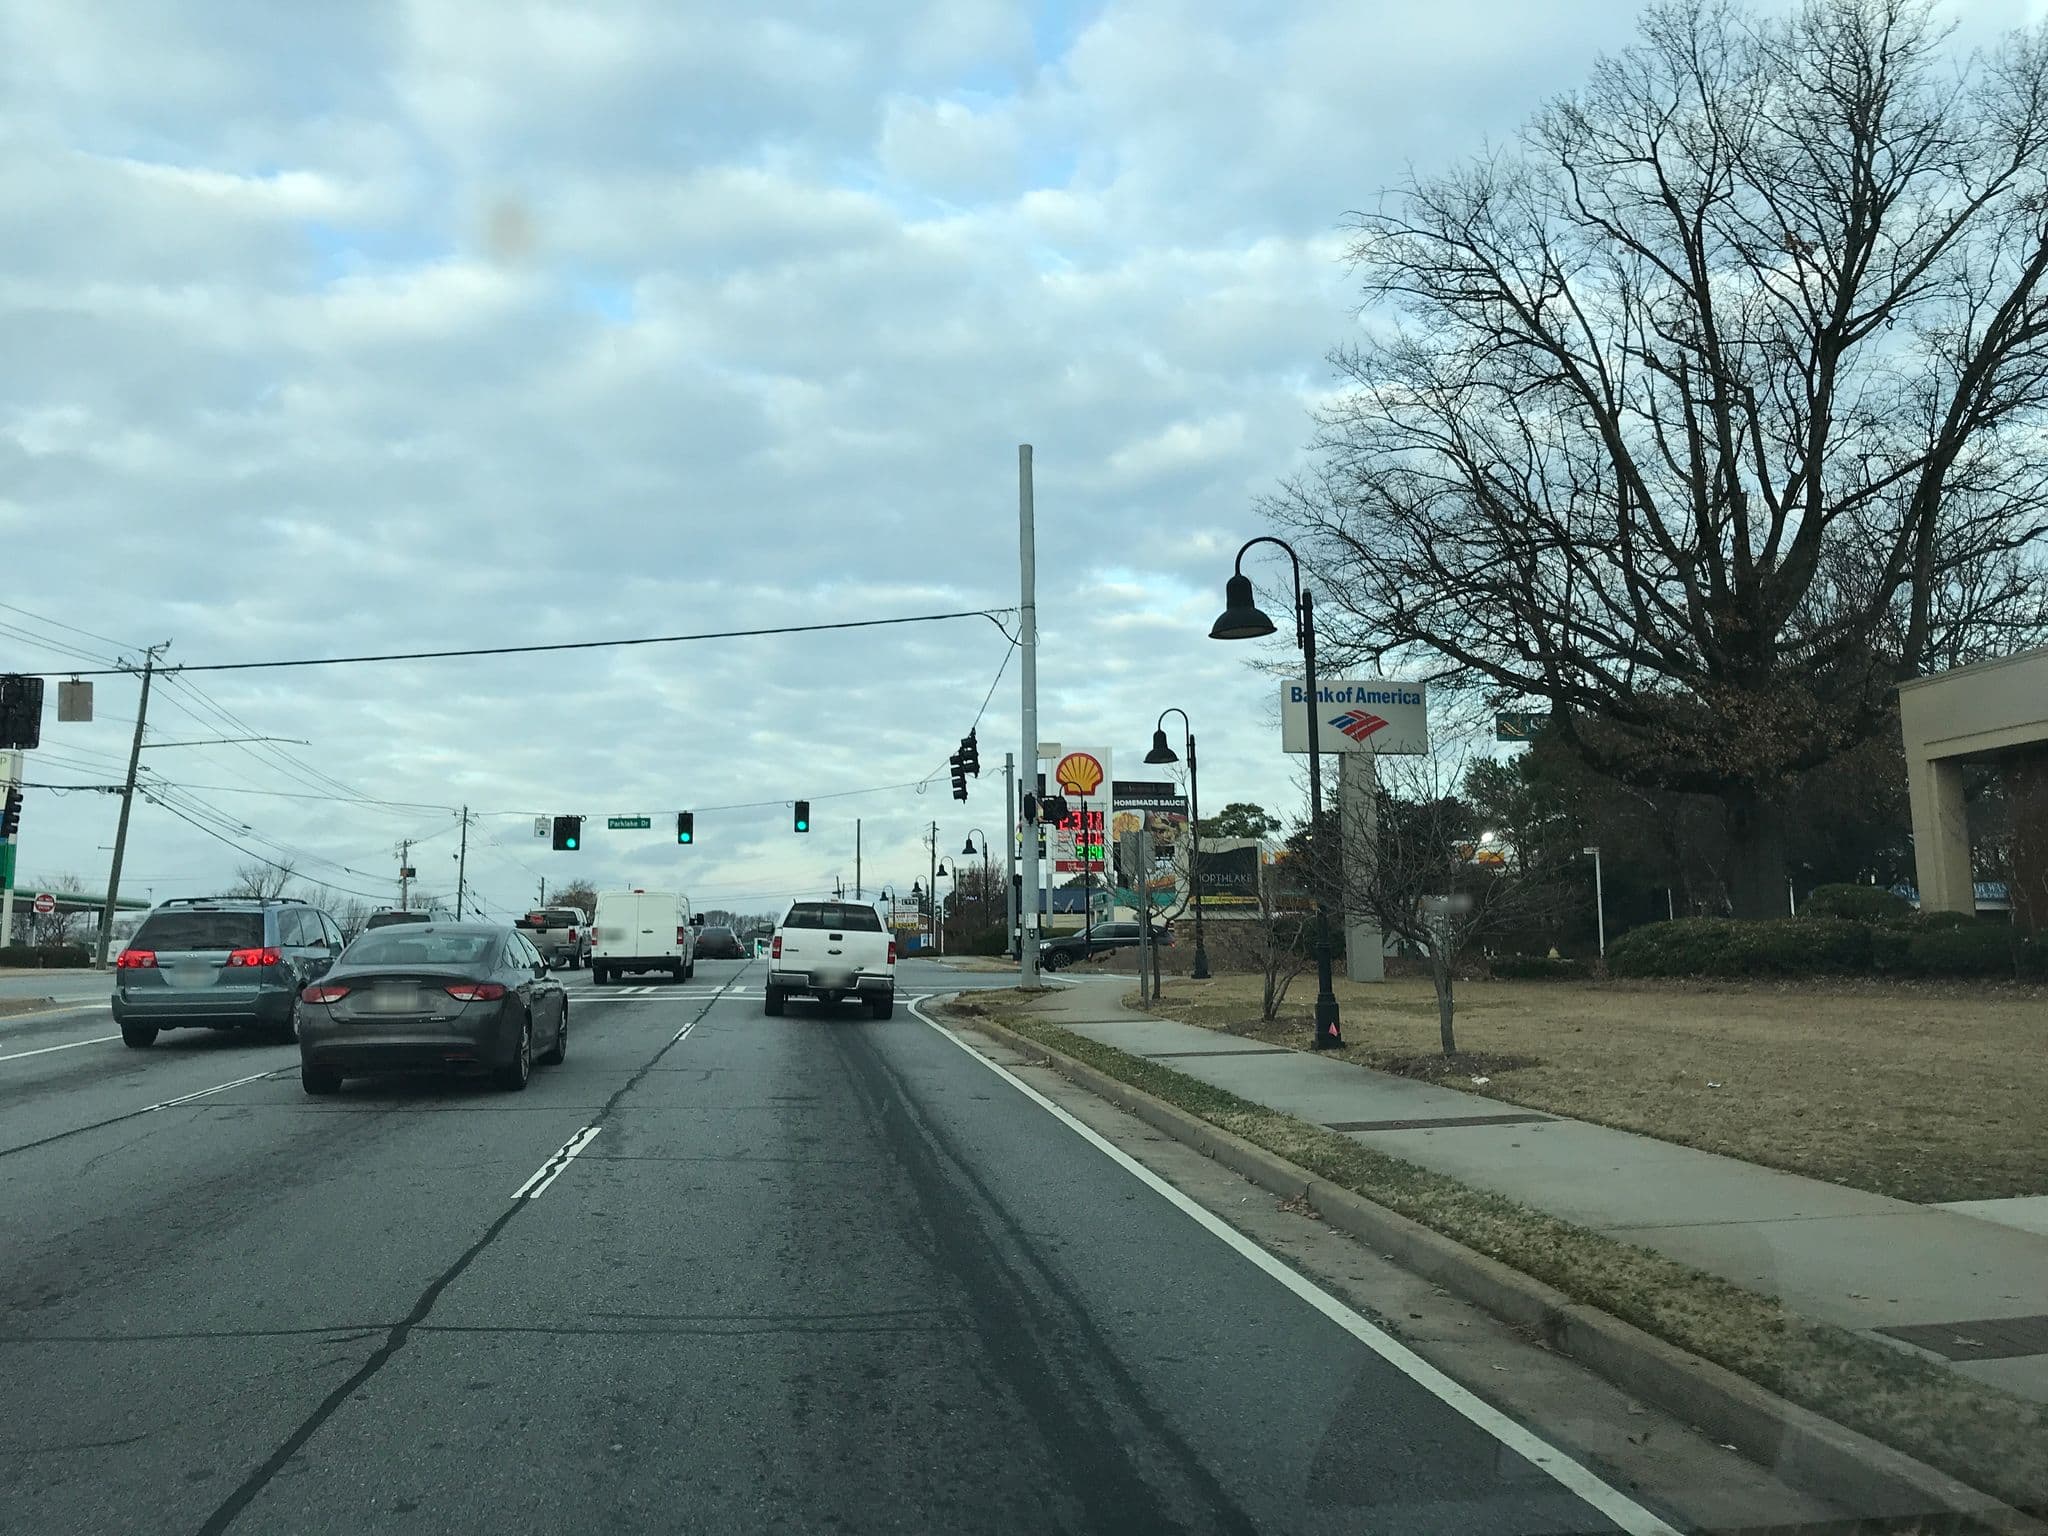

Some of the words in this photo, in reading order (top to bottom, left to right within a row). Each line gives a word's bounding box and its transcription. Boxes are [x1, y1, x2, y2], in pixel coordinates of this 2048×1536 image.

[1335, 686, 1353, 703] of
[1355, 687, 1421, 705] America
[1113, 799, 1158, 807] HOMEMADE
[1159, 799, 1185, 808] SAUCE
[609, 820, 638, 828] Parklake
[641, 820, 649, 828] Dr
